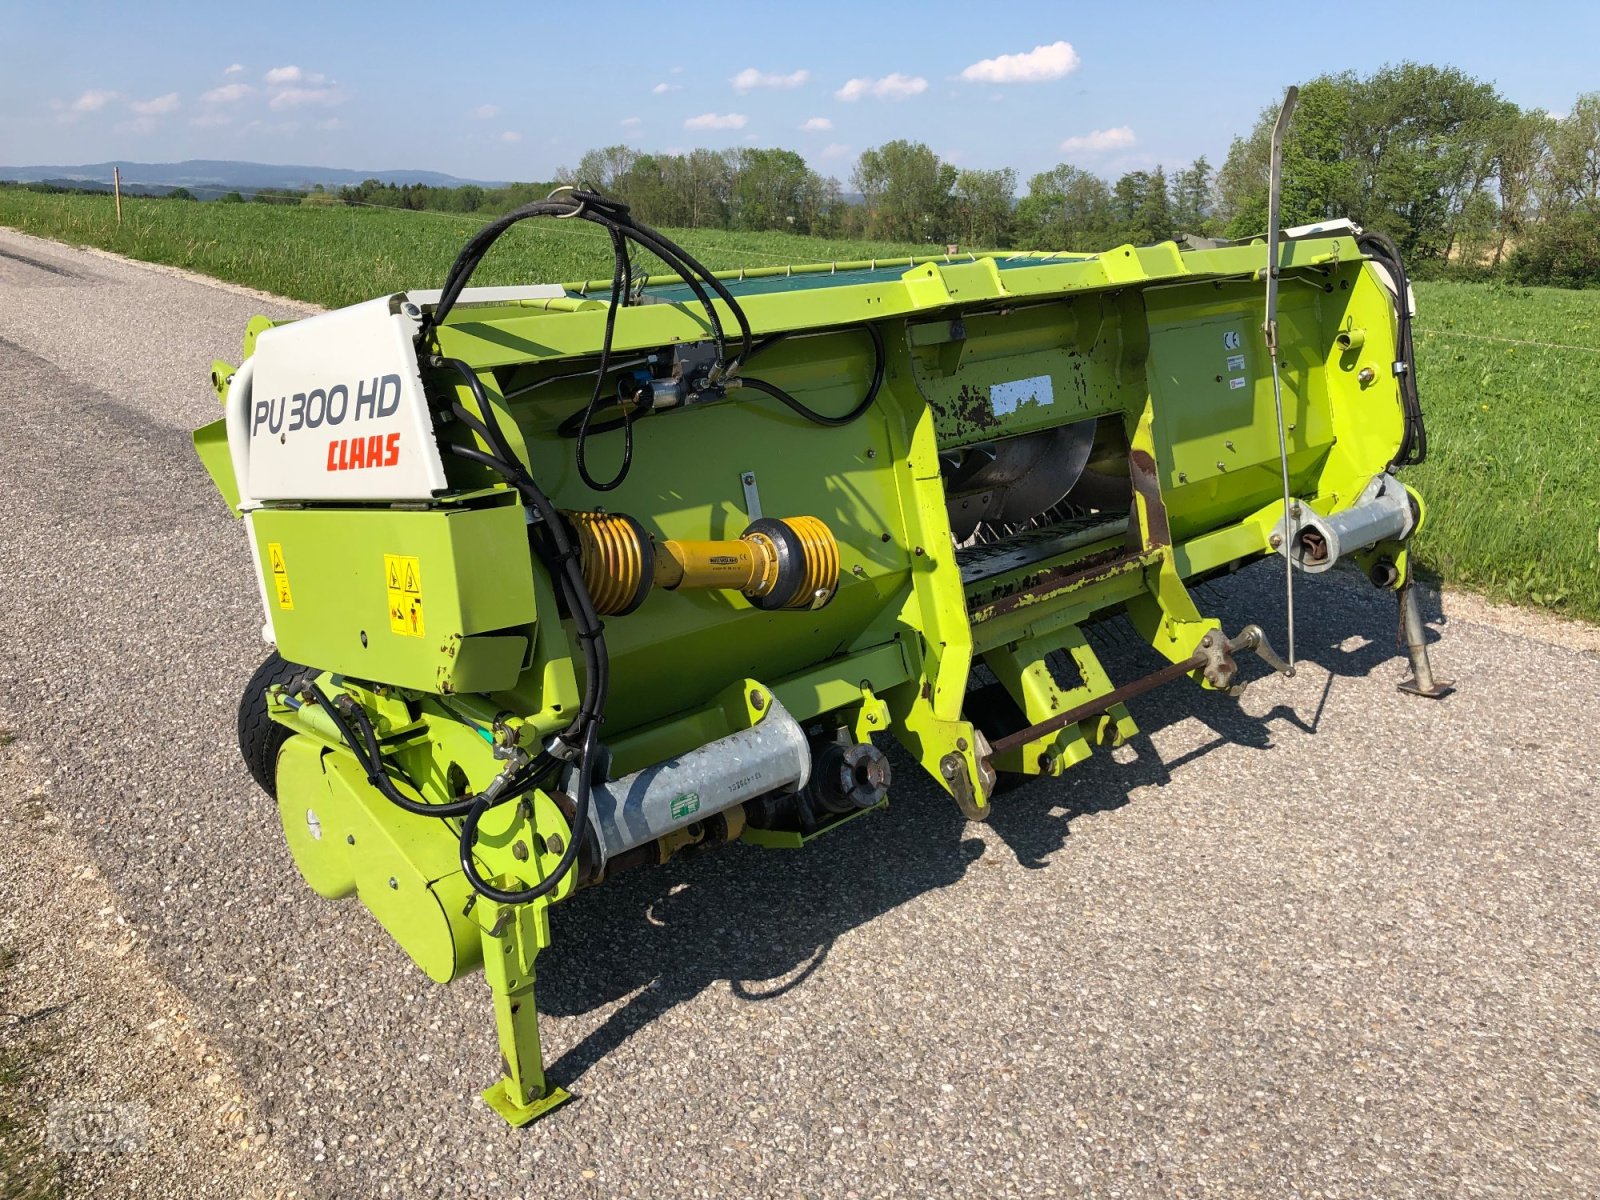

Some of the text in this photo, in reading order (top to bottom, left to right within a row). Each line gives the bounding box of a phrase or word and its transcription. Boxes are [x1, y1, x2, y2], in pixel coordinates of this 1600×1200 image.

[252, 373, 402, 437] PU 300 HD
[326, 432, 401, 472] CLAAS
